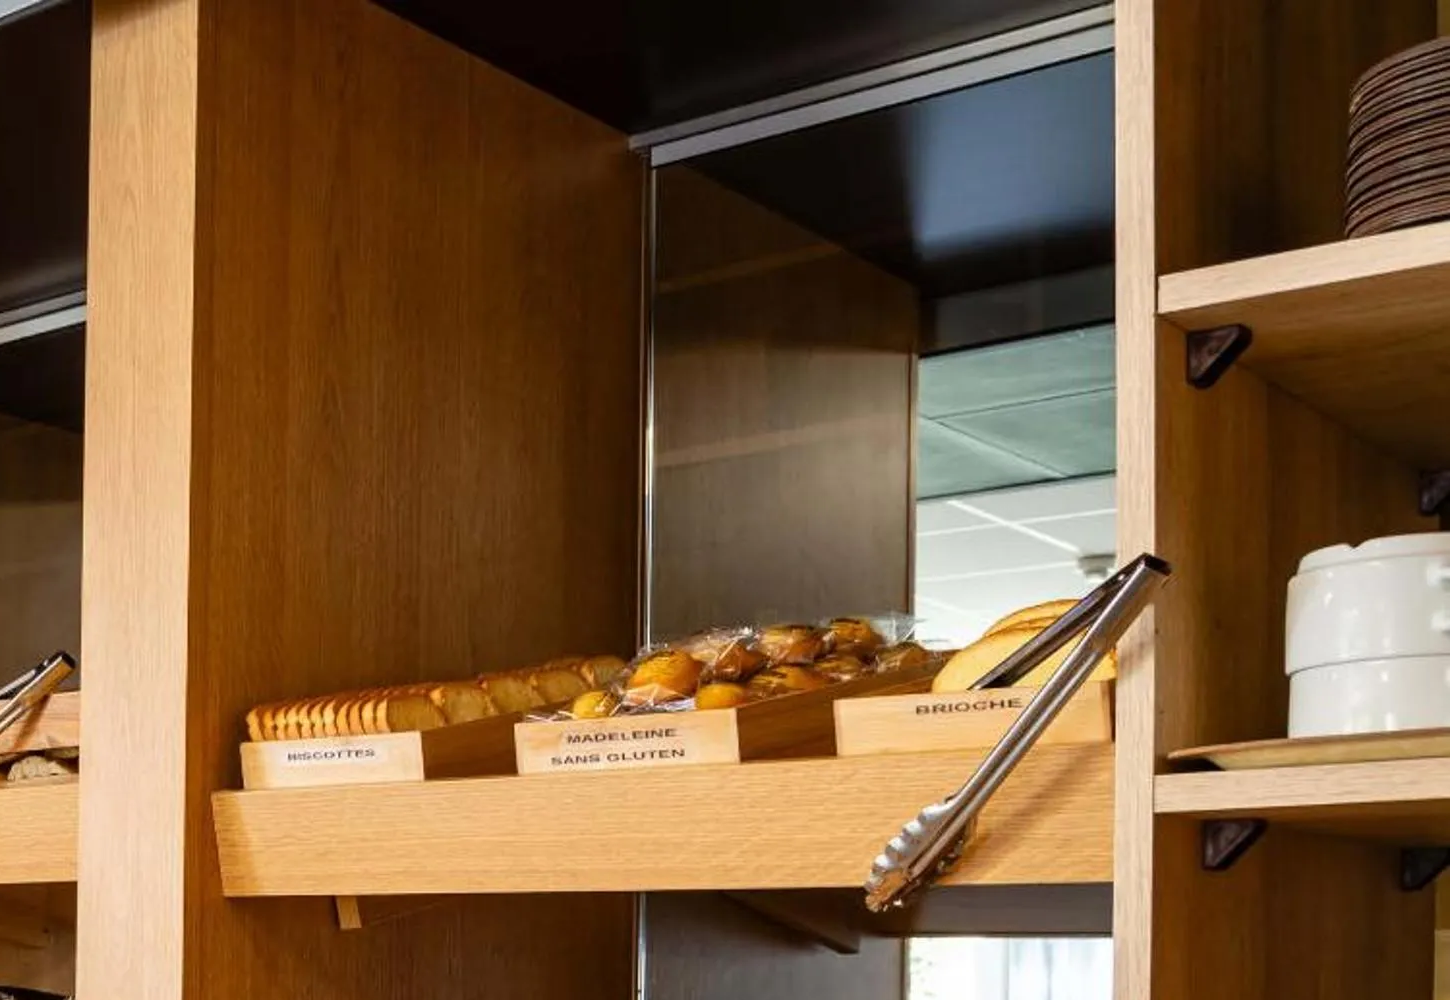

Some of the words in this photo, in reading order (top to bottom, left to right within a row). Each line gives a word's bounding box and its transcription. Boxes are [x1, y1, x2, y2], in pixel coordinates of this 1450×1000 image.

[915, 697, 1024, 715] BRIOCHE
[566, 727, 679, 745] MADELEINE
[286, 747, 377, 762] BISCOTTES
[550, 751, 601, 766] SANS
[605, 748, 687, 763] GLUTEN
